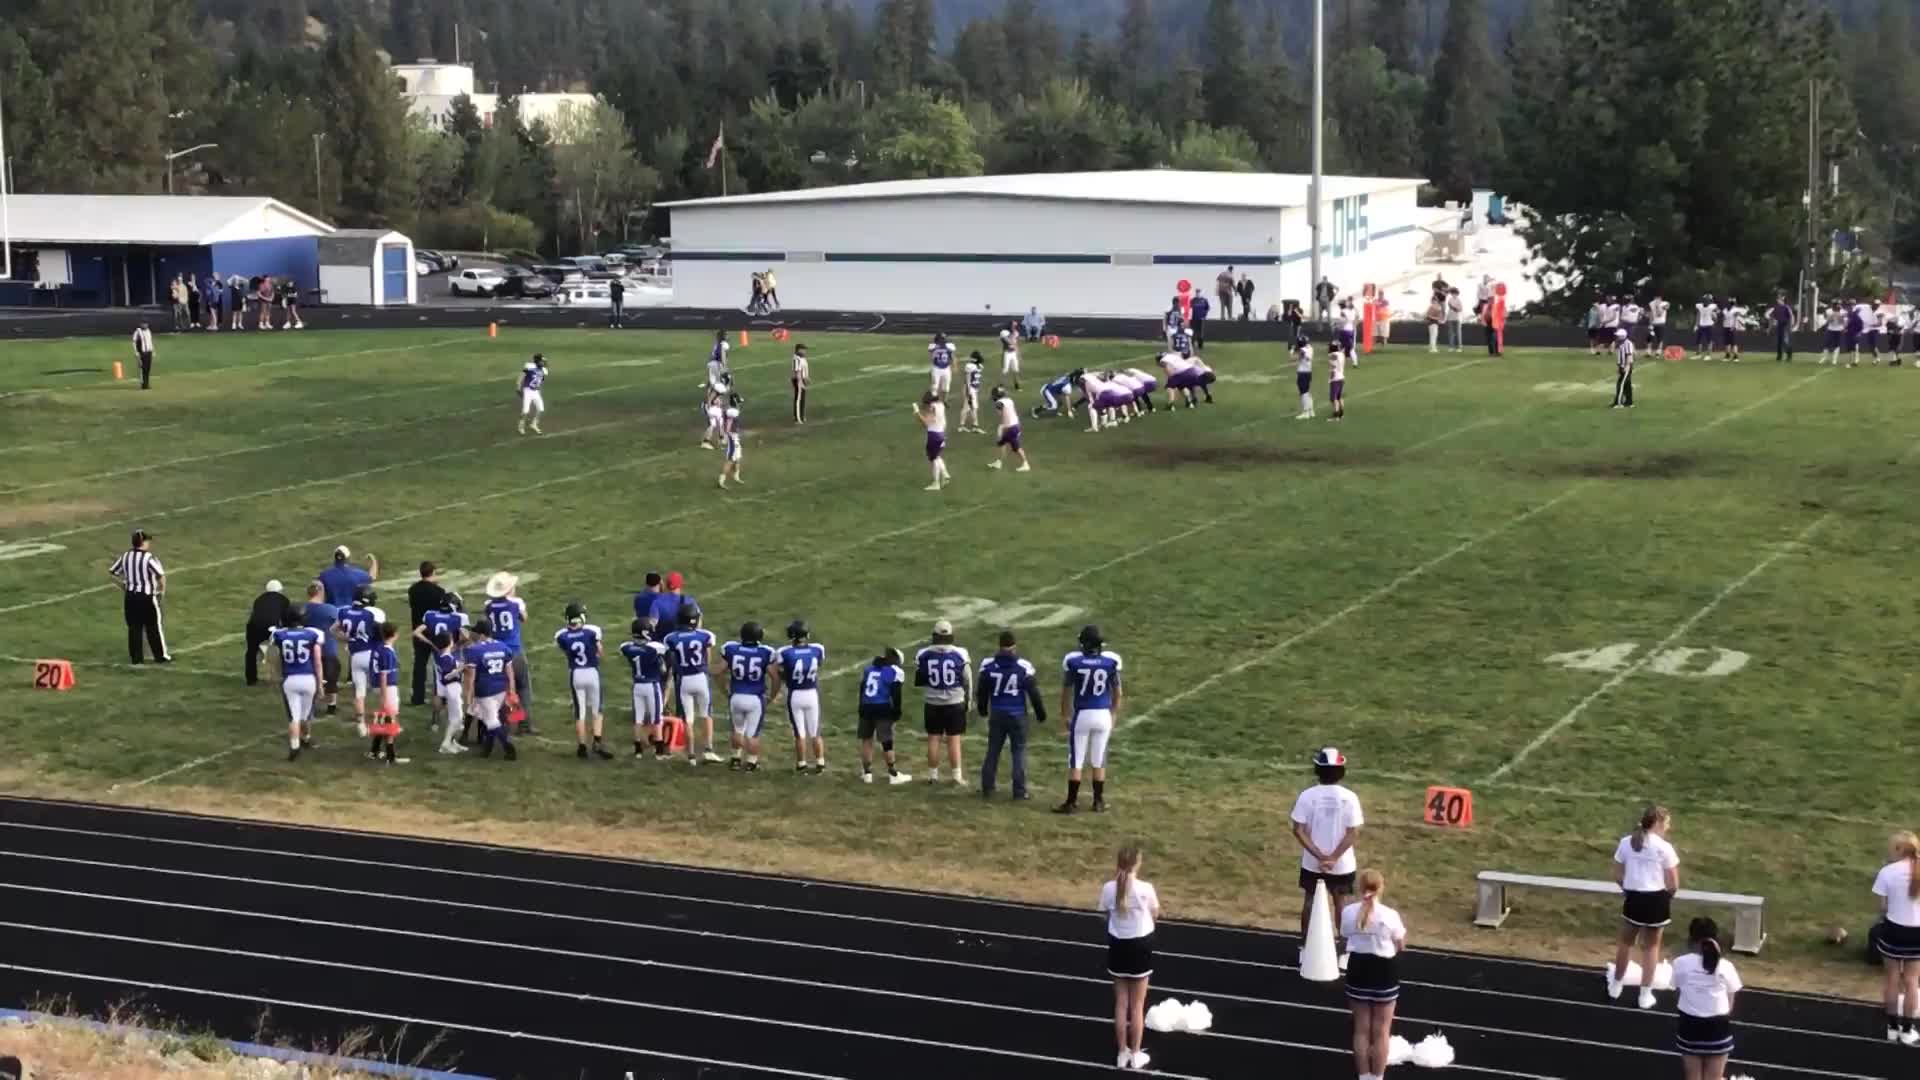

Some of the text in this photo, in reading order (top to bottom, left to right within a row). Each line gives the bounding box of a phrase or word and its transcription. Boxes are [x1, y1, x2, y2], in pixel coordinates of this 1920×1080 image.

[489, 611, 514, 632] 19
[895, 596, 1084, 629] 30
[281, 639, 310, 664] 65
[571, 641, 588, 666] 3
[676, 640, 703, 667] 13
[1543, 642, 1750, 676] 40
[36, 662, 62, 689] 20
[632, 655, 646, 679] 1
[731, 654, 763, 682] 55
[792, 656, 818, 684] 44
[927, 659, 956, 687] 56
[865, 671, 881, 697] 5
[990, 672, 1019, 696] 74
[1077, 668, 1108, 696] 78
[1427, 791, 1463, 824] 40
